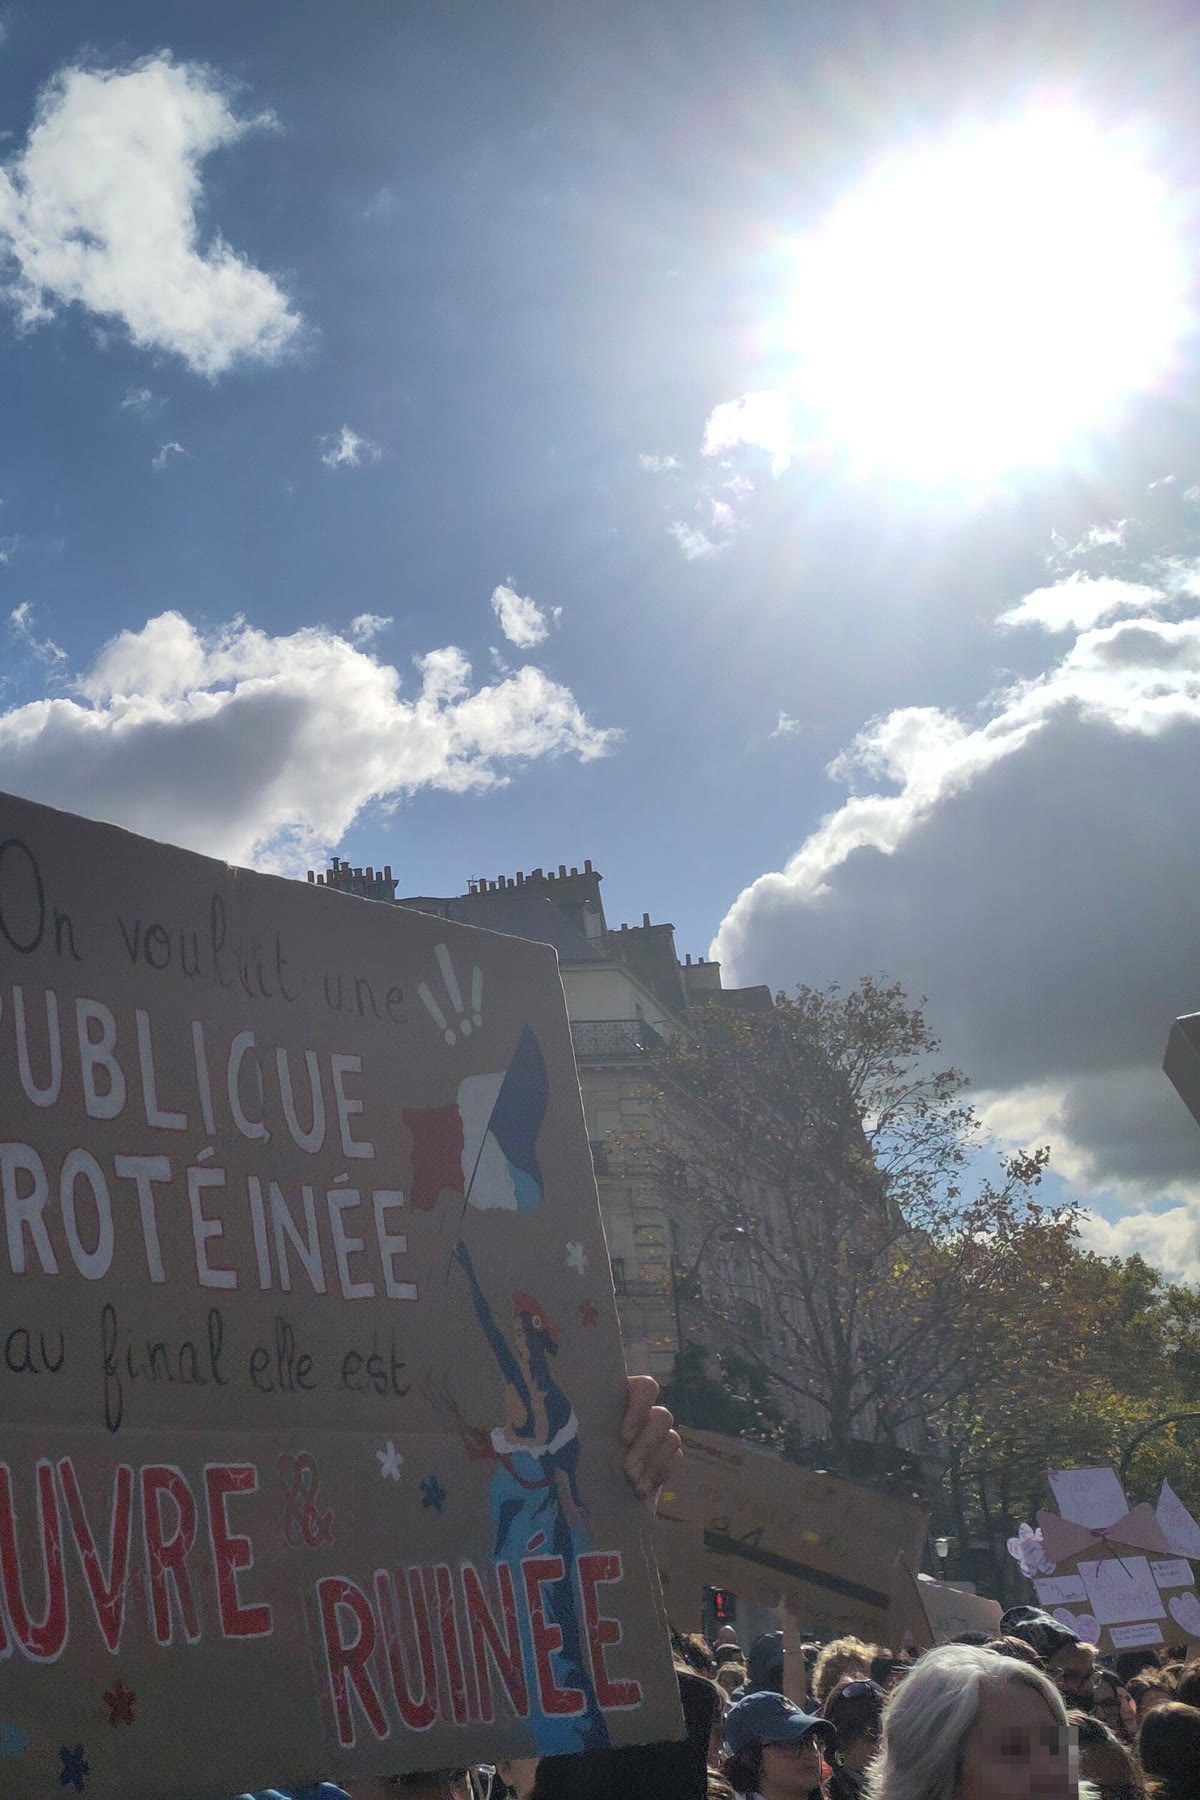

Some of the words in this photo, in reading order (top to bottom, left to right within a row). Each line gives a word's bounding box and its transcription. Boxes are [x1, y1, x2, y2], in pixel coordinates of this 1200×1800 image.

[324, 975, 409, 1024] une
[4, 1326, 66, 1375] au
[101, 1302, 230, 1434] final
[249, 1315, 319, 1393] elle
[340, 1327, 413, 1398] est
[276, 1451, 336, 1550] &
[314, 1532, 644, 1750] RUINÉE
